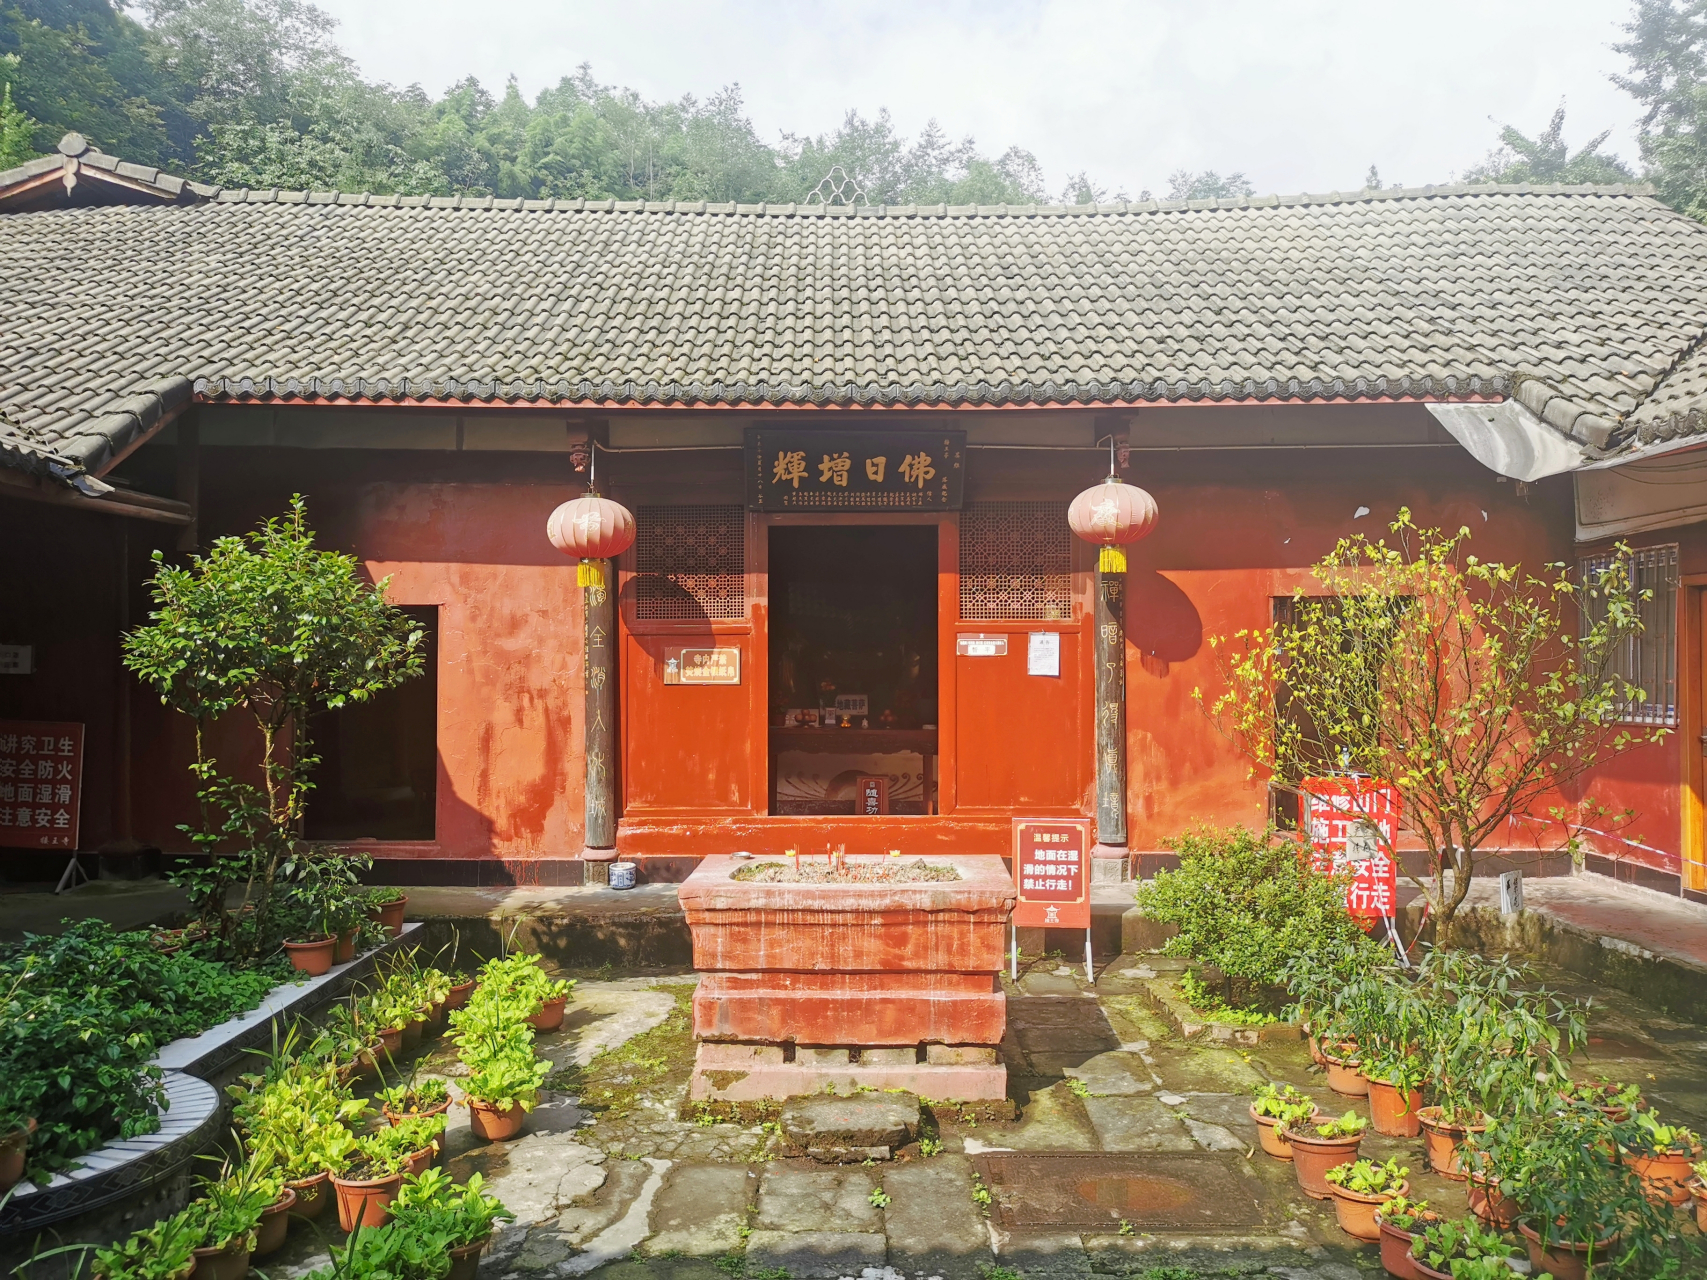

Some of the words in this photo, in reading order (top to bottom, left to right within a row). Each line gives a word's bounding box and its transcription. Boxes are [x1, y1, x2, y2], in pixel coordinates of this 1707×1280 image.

[0, 734, 75, 756] 讲究卫生
[0, 758, 73, 780] 安全防火
[0, 782, 72, 804] 地面湿滑
[0, 806, 71, 828] 注意安全
[1033, 833, 1069, 843] 温馨提示
[1310, 819, 1392, 845] 施工地
[1034, 849, 1079, 861] 地面在湿
[1023, 863, 1079, 876] 滑的情况下
[1343, 882, 1391, 910] 行走
